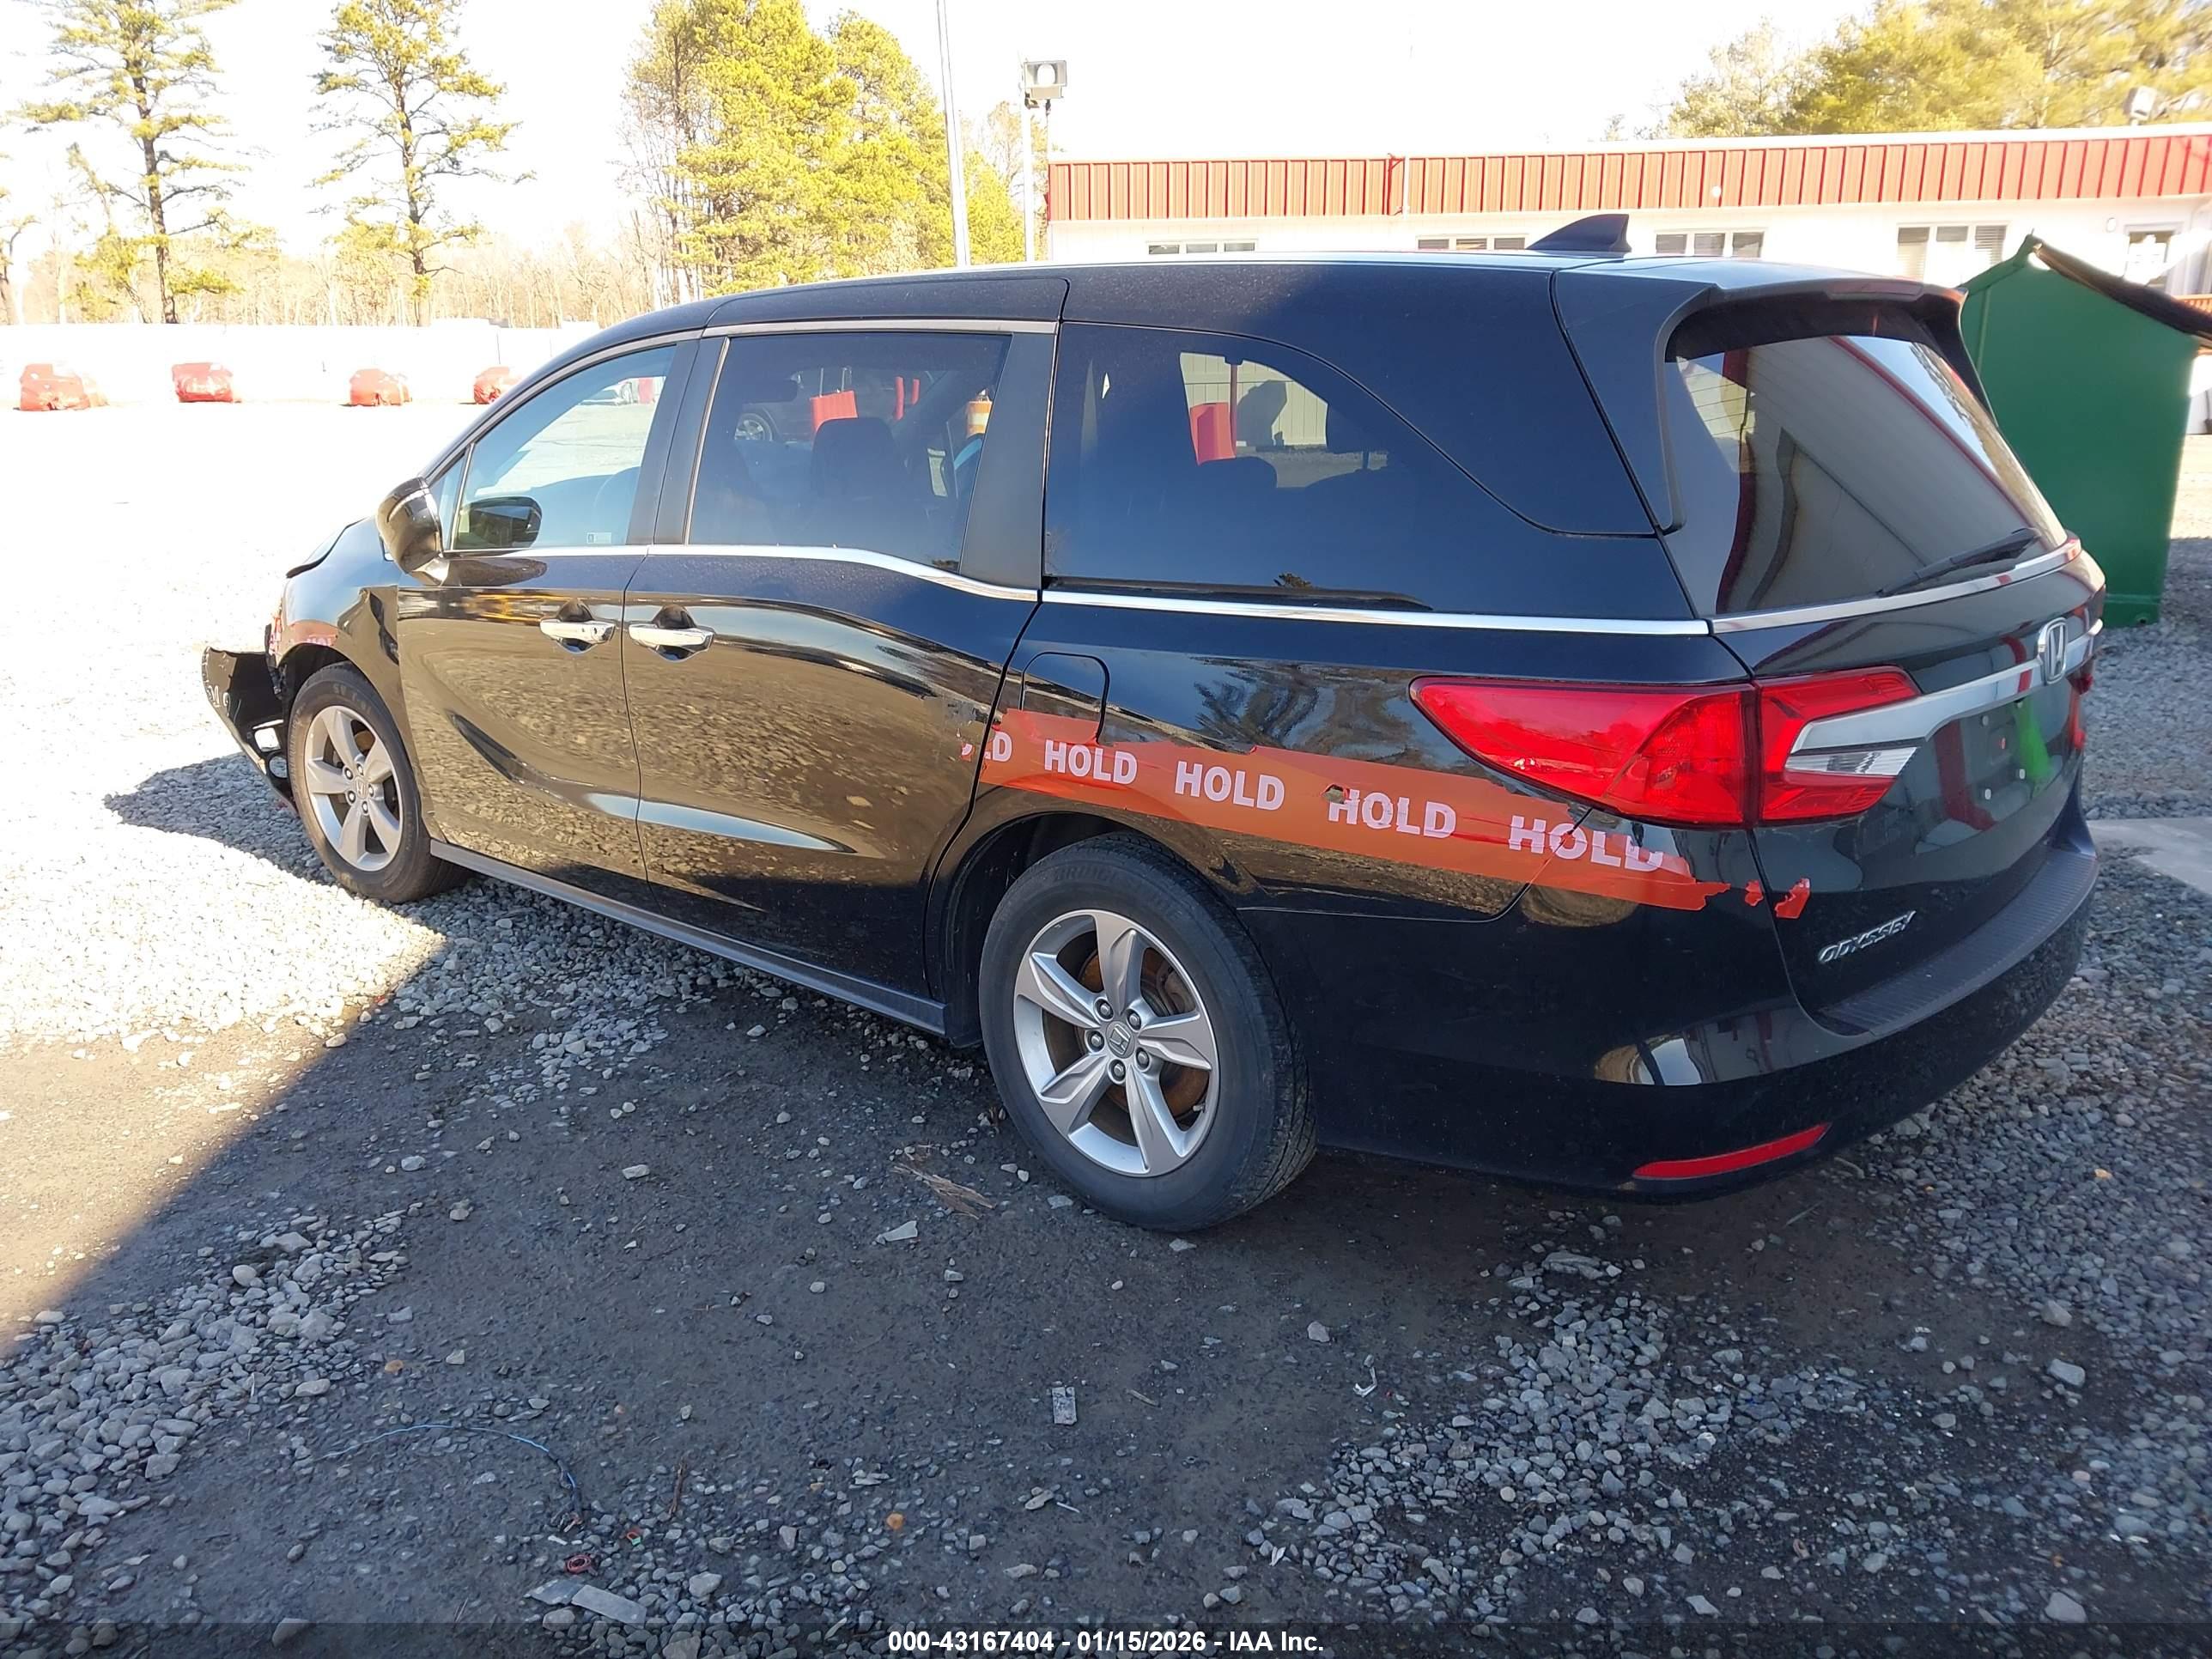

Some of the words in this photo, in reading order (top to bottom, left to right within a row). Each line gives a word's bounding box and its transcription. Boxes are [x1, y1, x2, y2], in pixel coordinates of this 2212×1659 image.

[1044, 739, 1138, 785] HOLD
[1175, 761, 1285, 811] HOLD
[1328, 789, 1456, 839] HOLD
[1818, 910, 1917, 963] ODYSSEY
